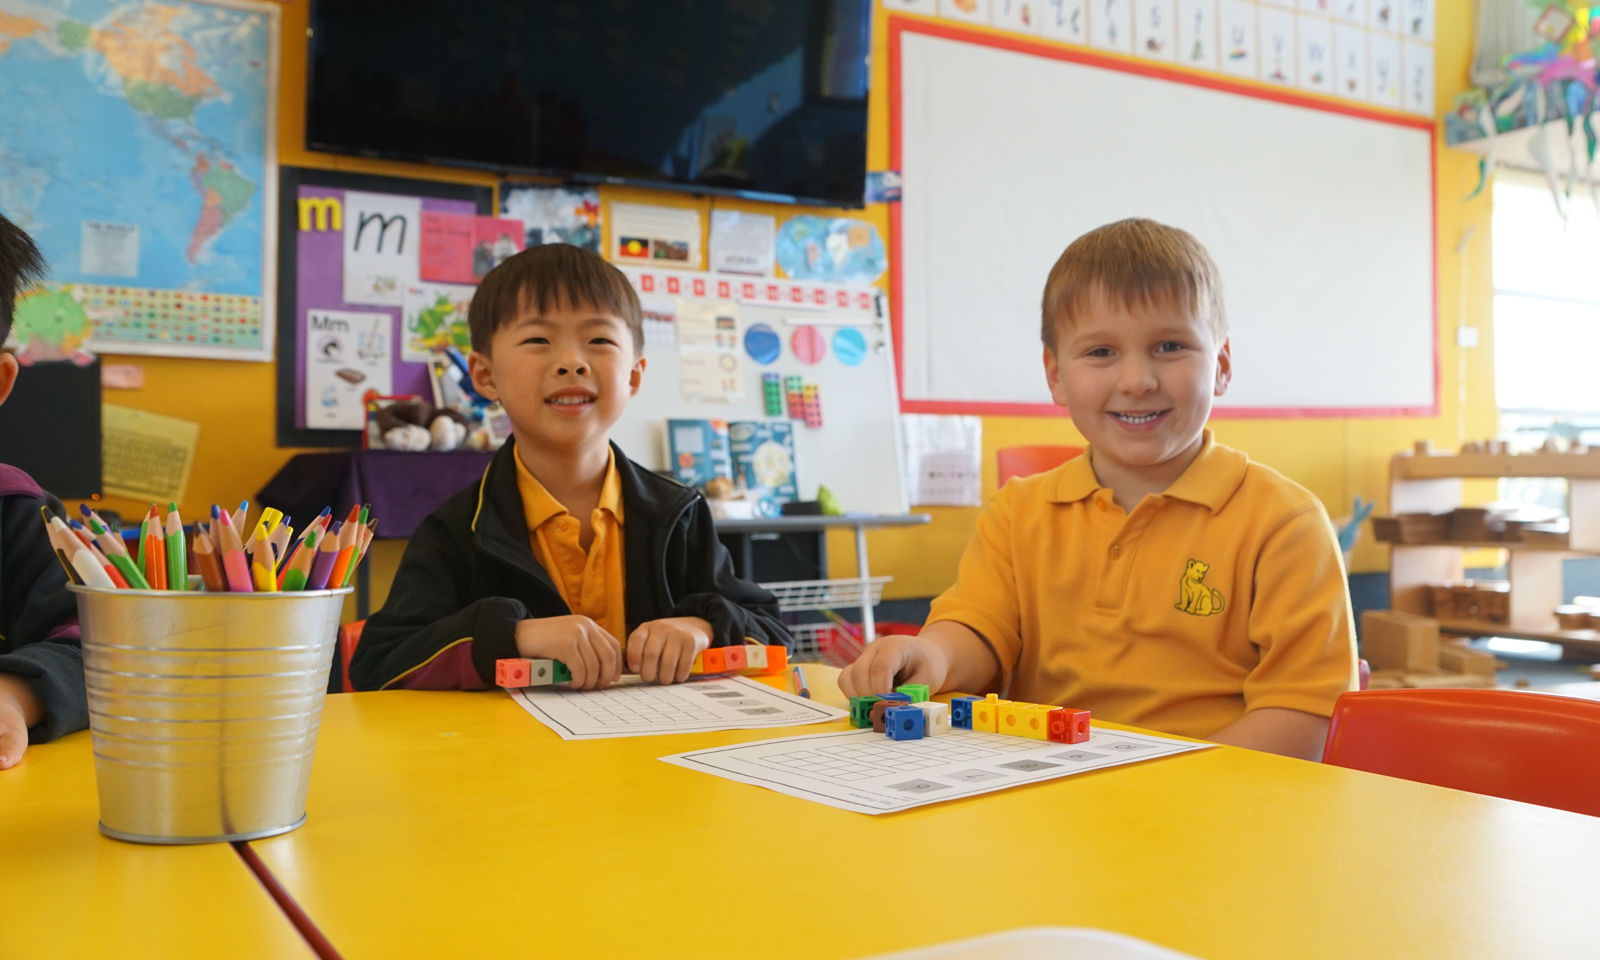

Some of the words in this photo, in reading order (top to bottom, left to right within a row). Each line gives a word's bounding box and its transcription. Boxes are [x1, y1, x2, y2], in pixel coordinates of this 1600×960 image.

[298, 197, 342, 232] m
[353, 211, 407, 255] m
[311, 316, 350, 332] Mm
